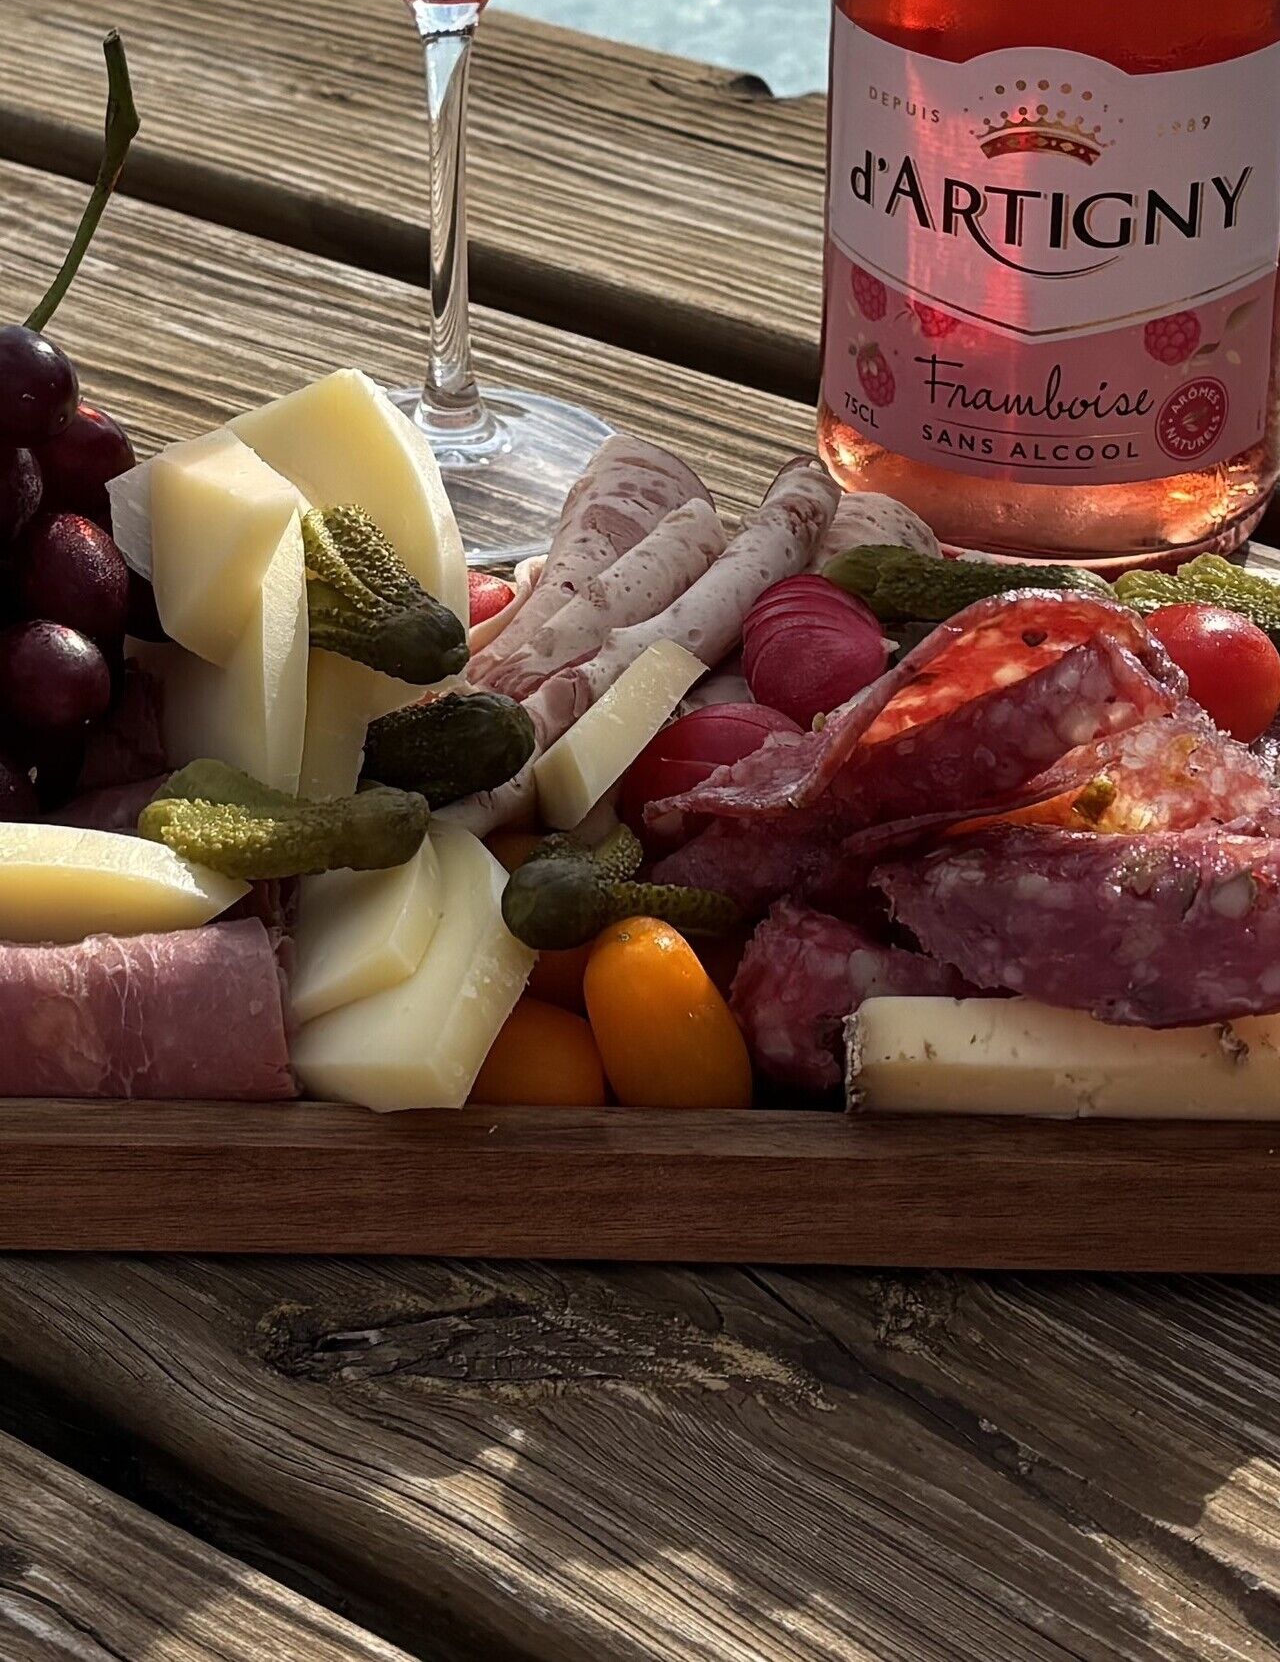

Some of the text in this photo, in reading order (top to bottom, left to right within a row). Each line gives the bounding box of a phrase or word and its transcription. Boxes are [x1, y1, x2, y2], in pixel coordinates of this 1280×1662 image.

[868, 85, 1212, 138] DEPUIS 989
[850, 150, 1254, 280] d'ARTIGNY
[914, 352, 1155, 421] Framboise
[1170, 385, 1221, 414] ARÔMES
[844, 391, 881, 430] 75CL
[921, 423, 1141, 463] SANS ALCOOL
[1166, 415, 1221, 451] NATURELS
